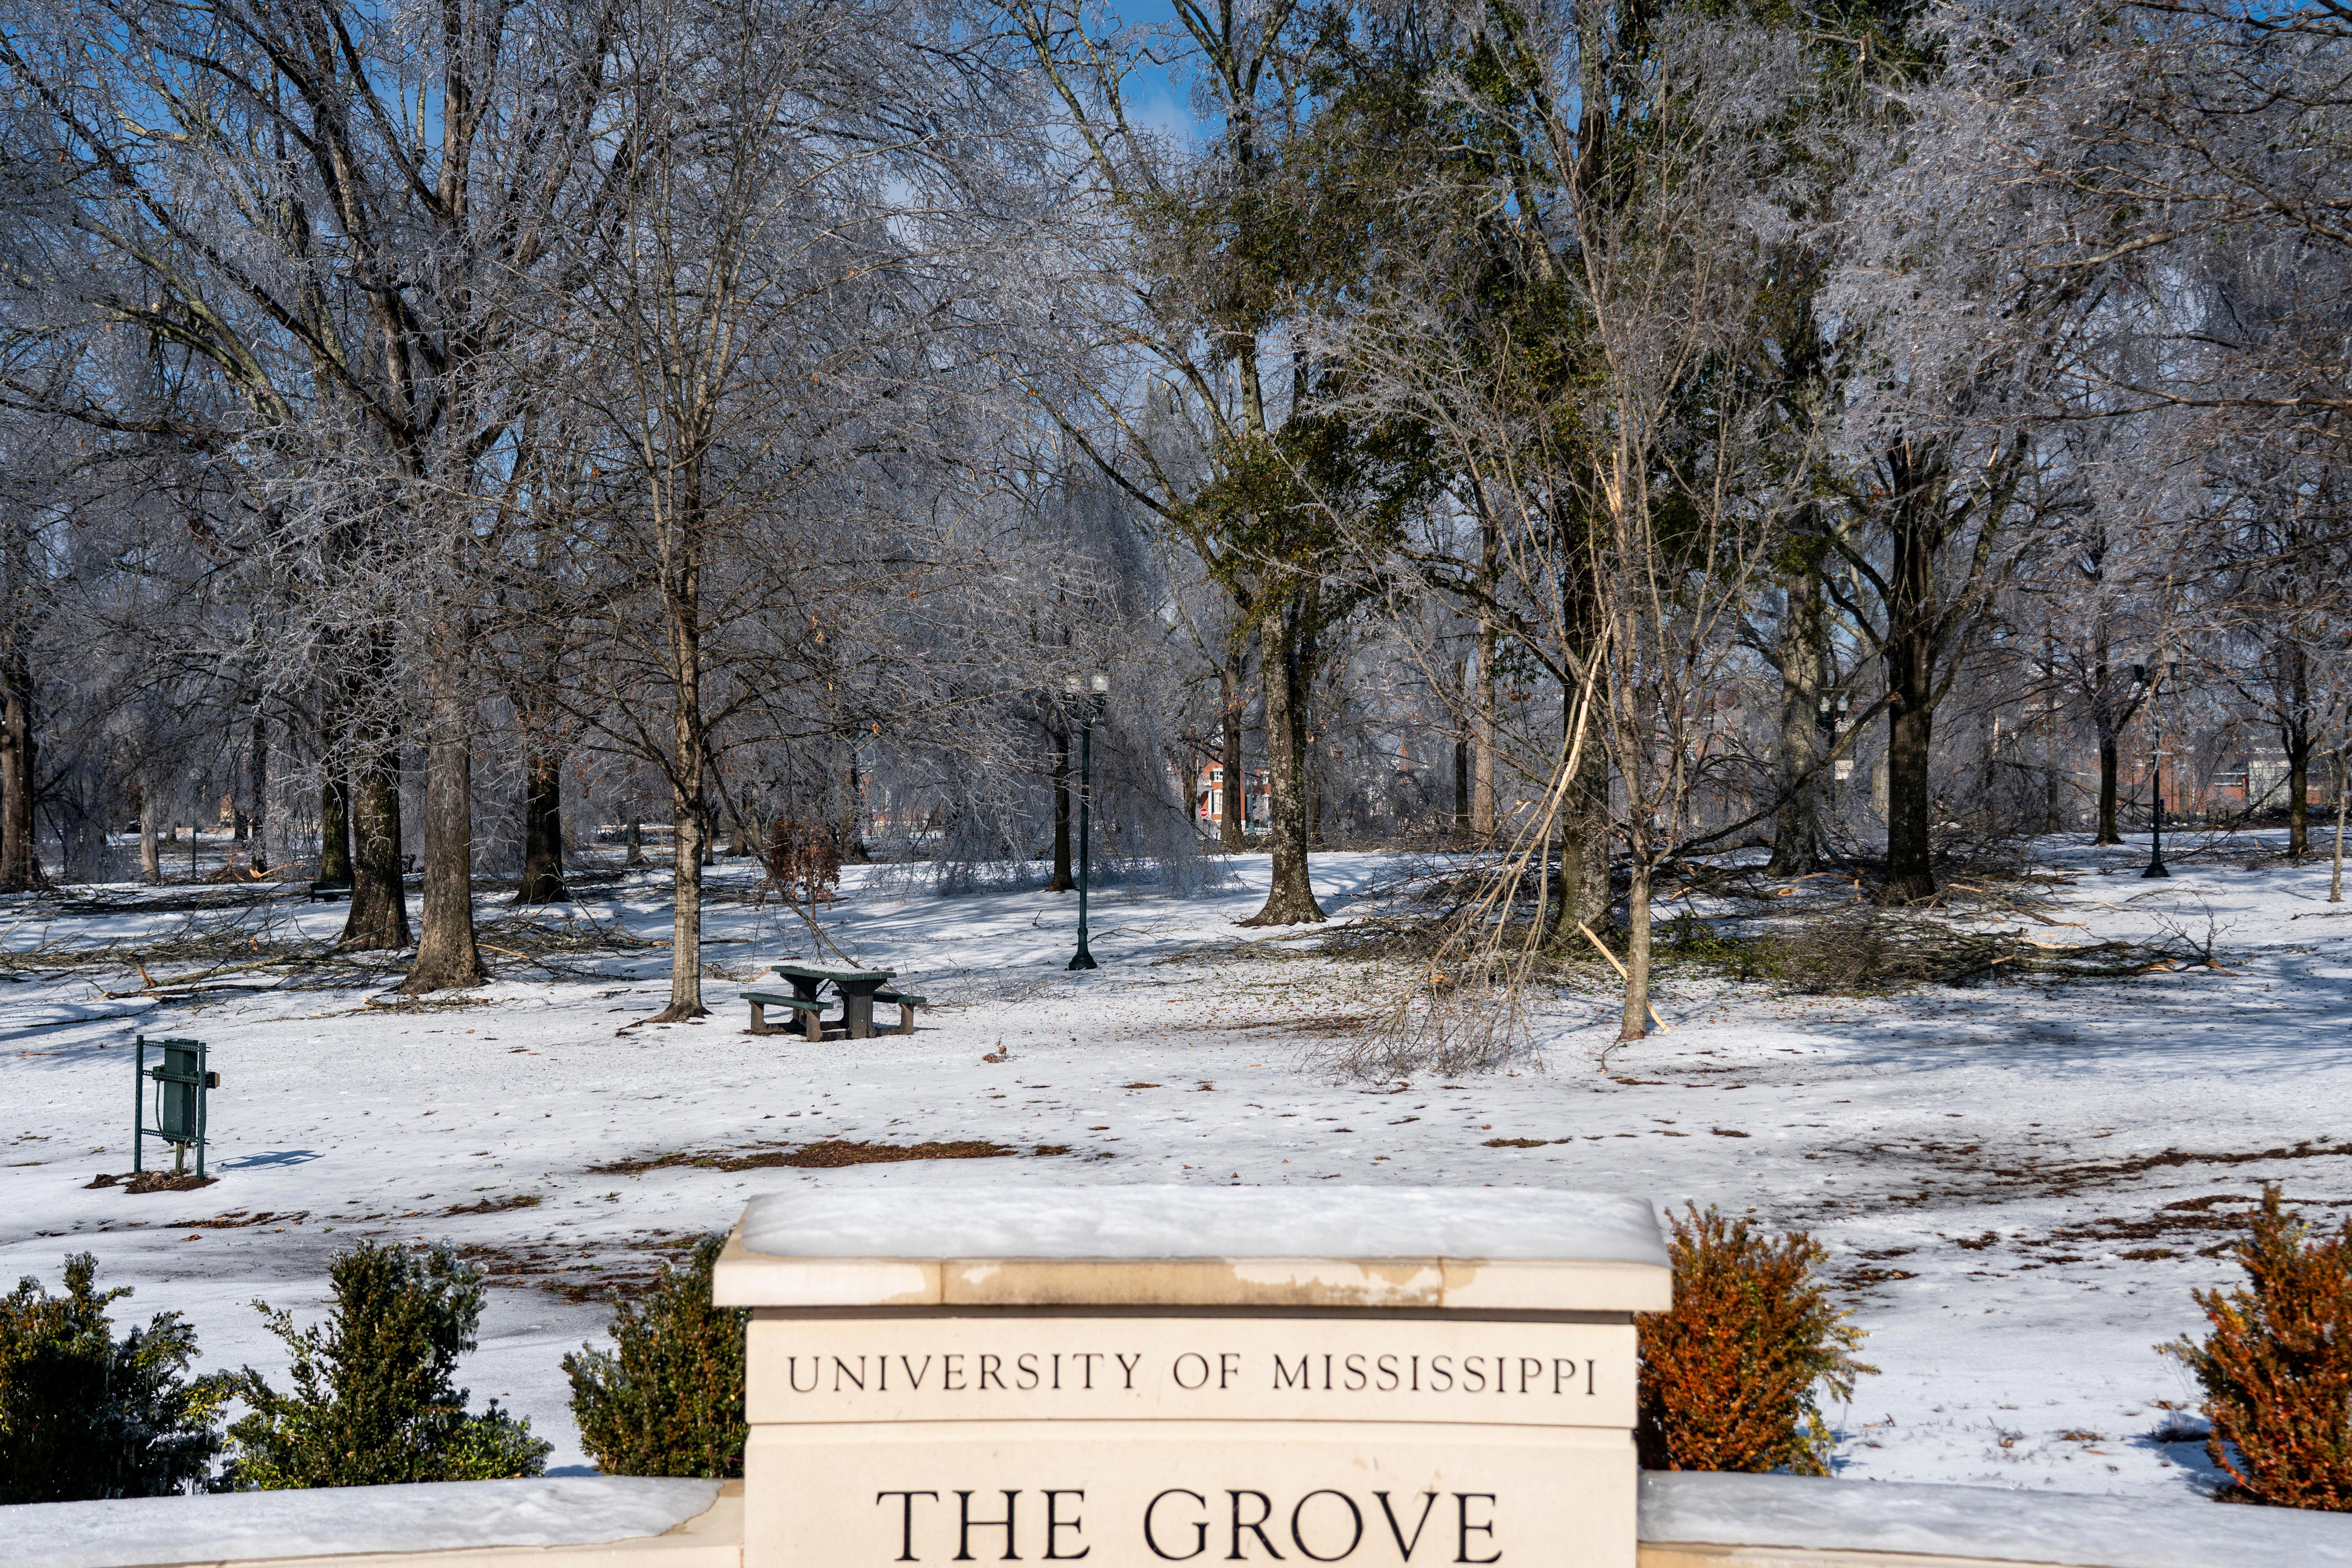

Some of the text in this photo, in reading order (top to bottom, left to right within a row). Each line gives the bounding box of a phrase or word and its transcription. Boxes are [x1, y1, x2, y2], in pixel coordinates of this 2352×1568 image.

[788, 1353, 1595, 1395] UNIVERSITY OF MISSISSIPPI
[876, 1488, 1503, 1565] THE GROVE
